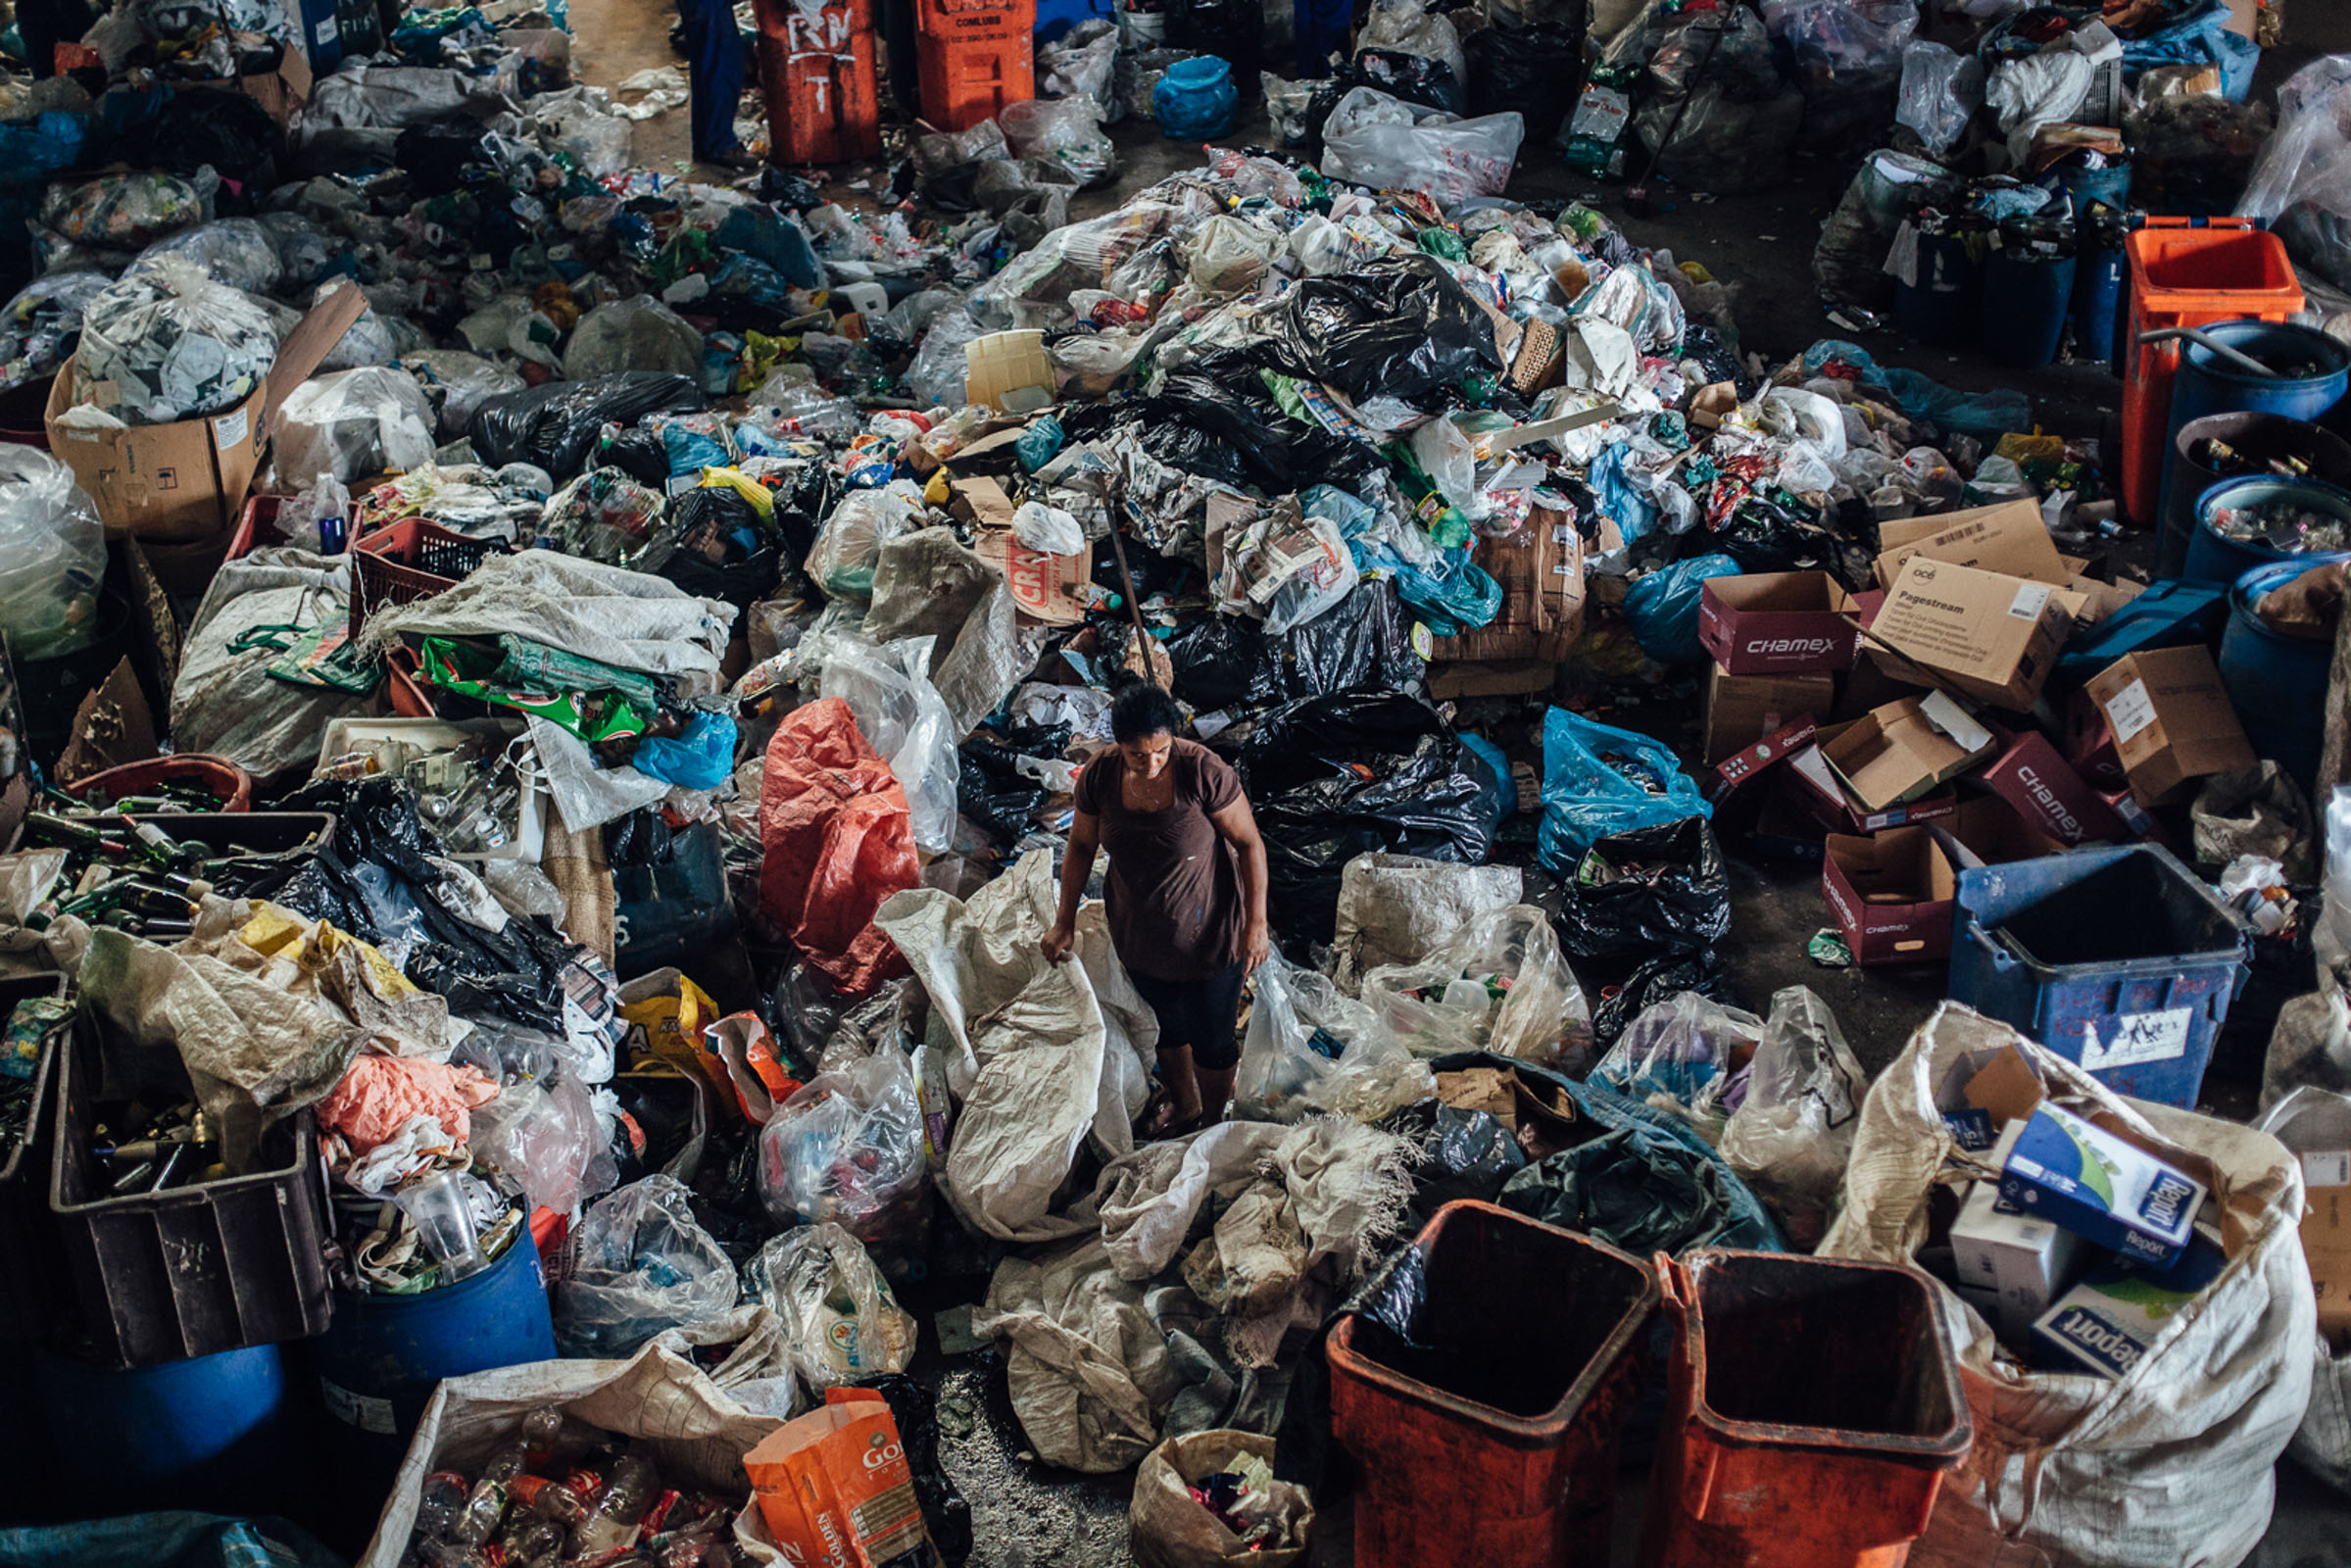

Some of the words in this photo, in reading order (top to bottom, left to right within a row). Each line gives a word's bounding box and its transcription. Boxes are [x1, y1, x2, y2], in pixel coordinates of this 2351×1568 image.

[1898, 590, 1965, 614] Pagestream
[627, 1023, 652, 1054] A
[2144, 1176, 2193, 1229] Report
[2127, 1229, 2168, 1258] Report
